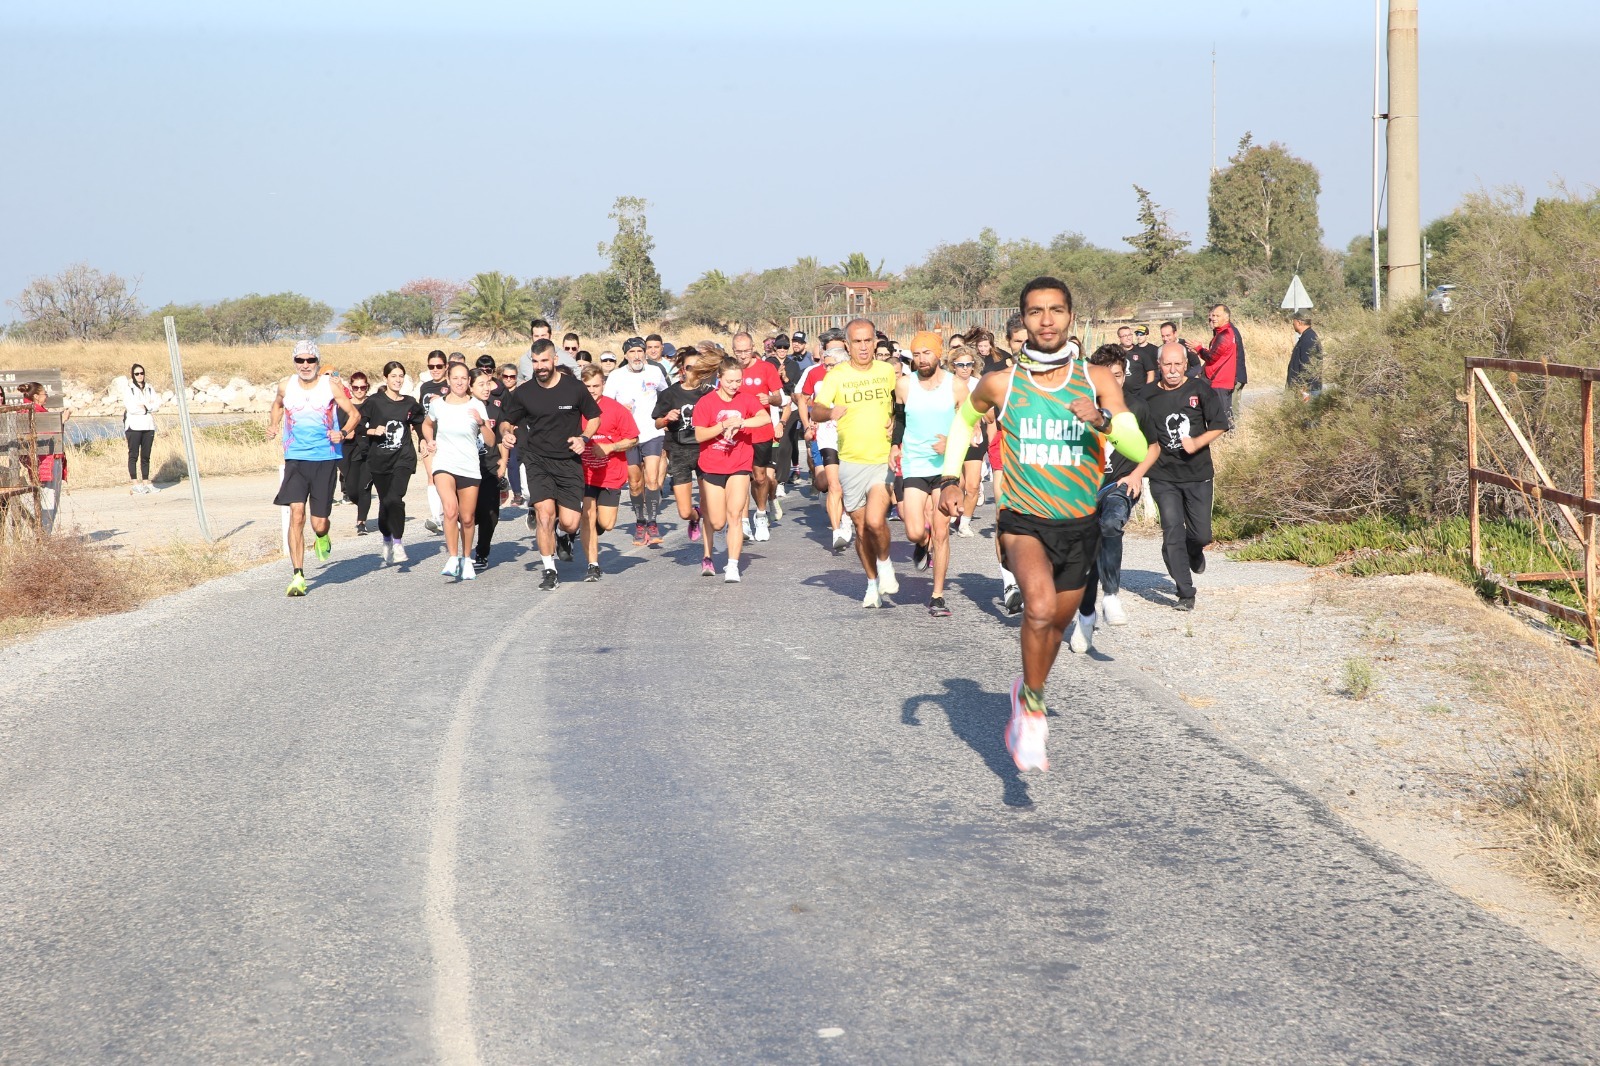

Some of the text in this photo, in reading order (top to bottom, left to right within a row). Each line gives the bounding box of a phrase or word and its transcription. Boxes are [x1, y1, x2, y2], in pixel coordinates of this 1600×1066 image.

[5, 373, 16, 381] SU
[844, 387, 890, 404] LÖSEV
[1019, 413, 1085, 441] ALİ GALİP
[1019, 438, 1084, 469] İNŞAAT
